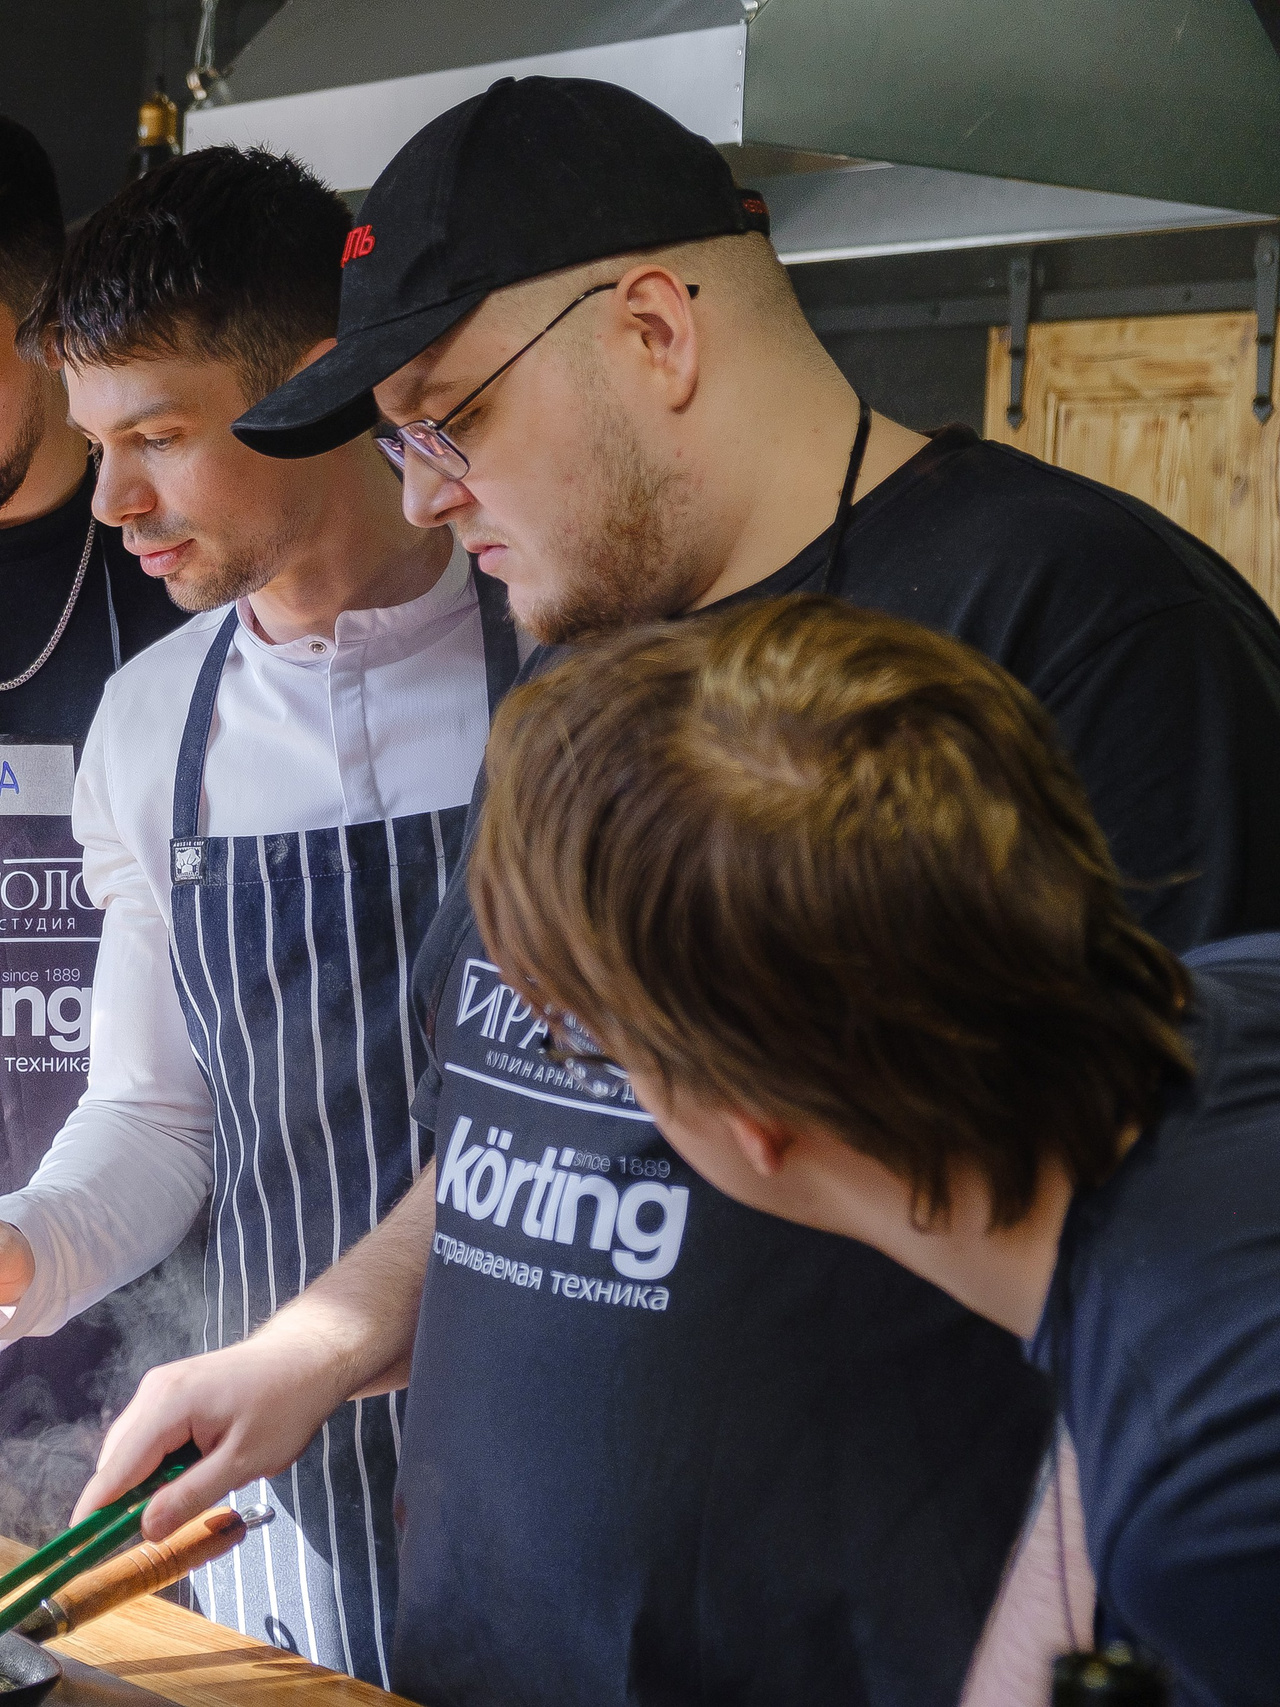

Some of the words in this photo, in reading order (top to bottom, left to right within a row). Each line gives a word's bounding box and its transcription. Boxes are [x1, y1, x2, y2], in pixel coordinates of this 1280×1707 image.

[1, 968, 40, 983] since
[44, 967, 81, 983] 1889
[4, 1056, 92, 1073] техника
[573, 1149, 612, 1173] since
[617, 1155, 672, 1179] 1889
[436, 1114, 690, 1281] körting
[432, 1230, 544, 1291] страиваемая
[549, 1269, 671, 1312] техника
